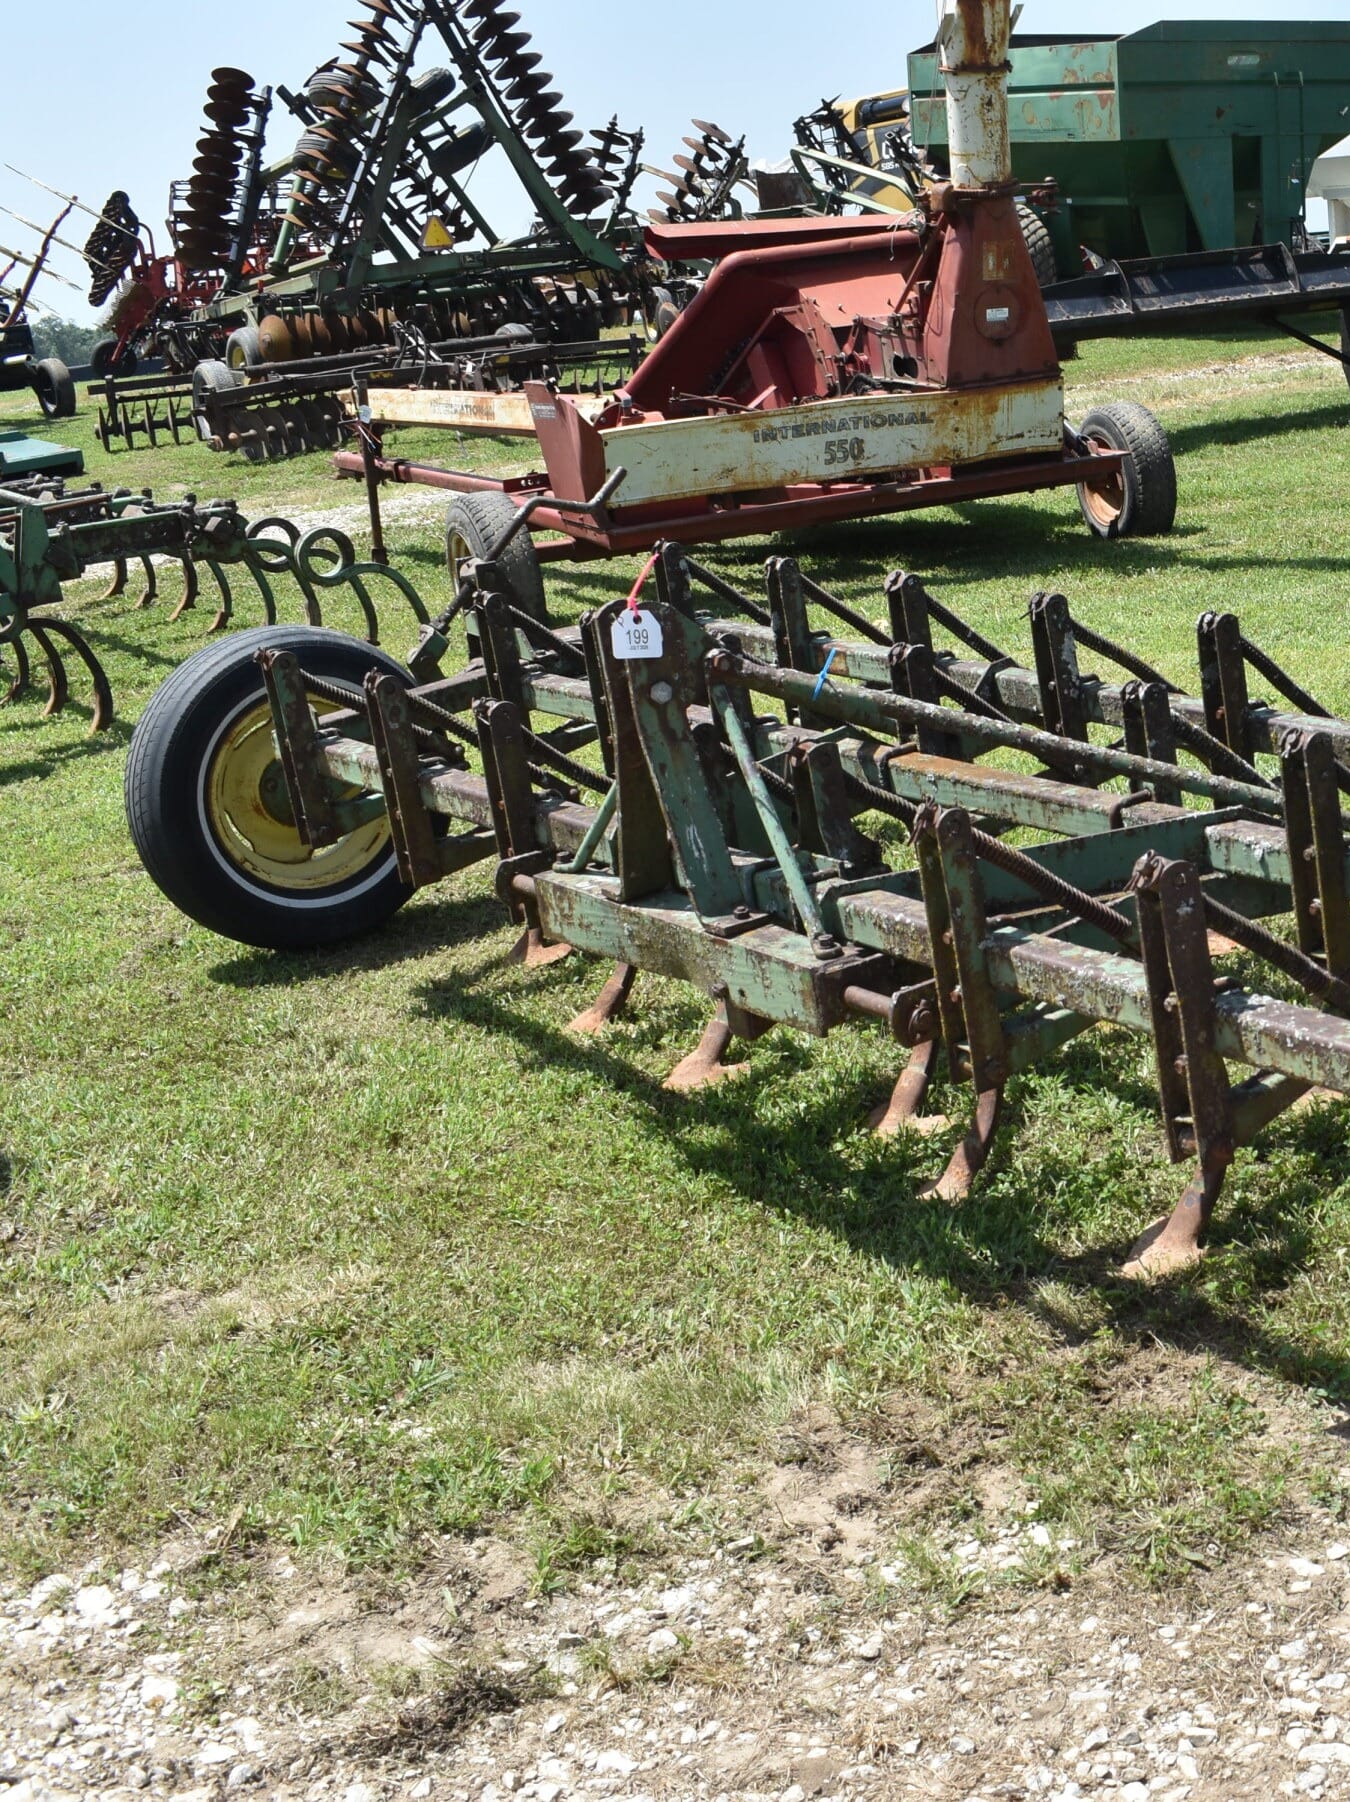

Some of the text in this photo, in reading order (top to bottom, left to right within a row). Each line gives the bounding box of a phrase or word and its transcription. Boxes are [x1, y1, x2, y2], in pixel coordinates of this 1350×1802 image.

[753, 411, 934, 443] INTERNATIONAL
[824, 437, 864, 466] 550
[626, 629, 649, 645] 199
